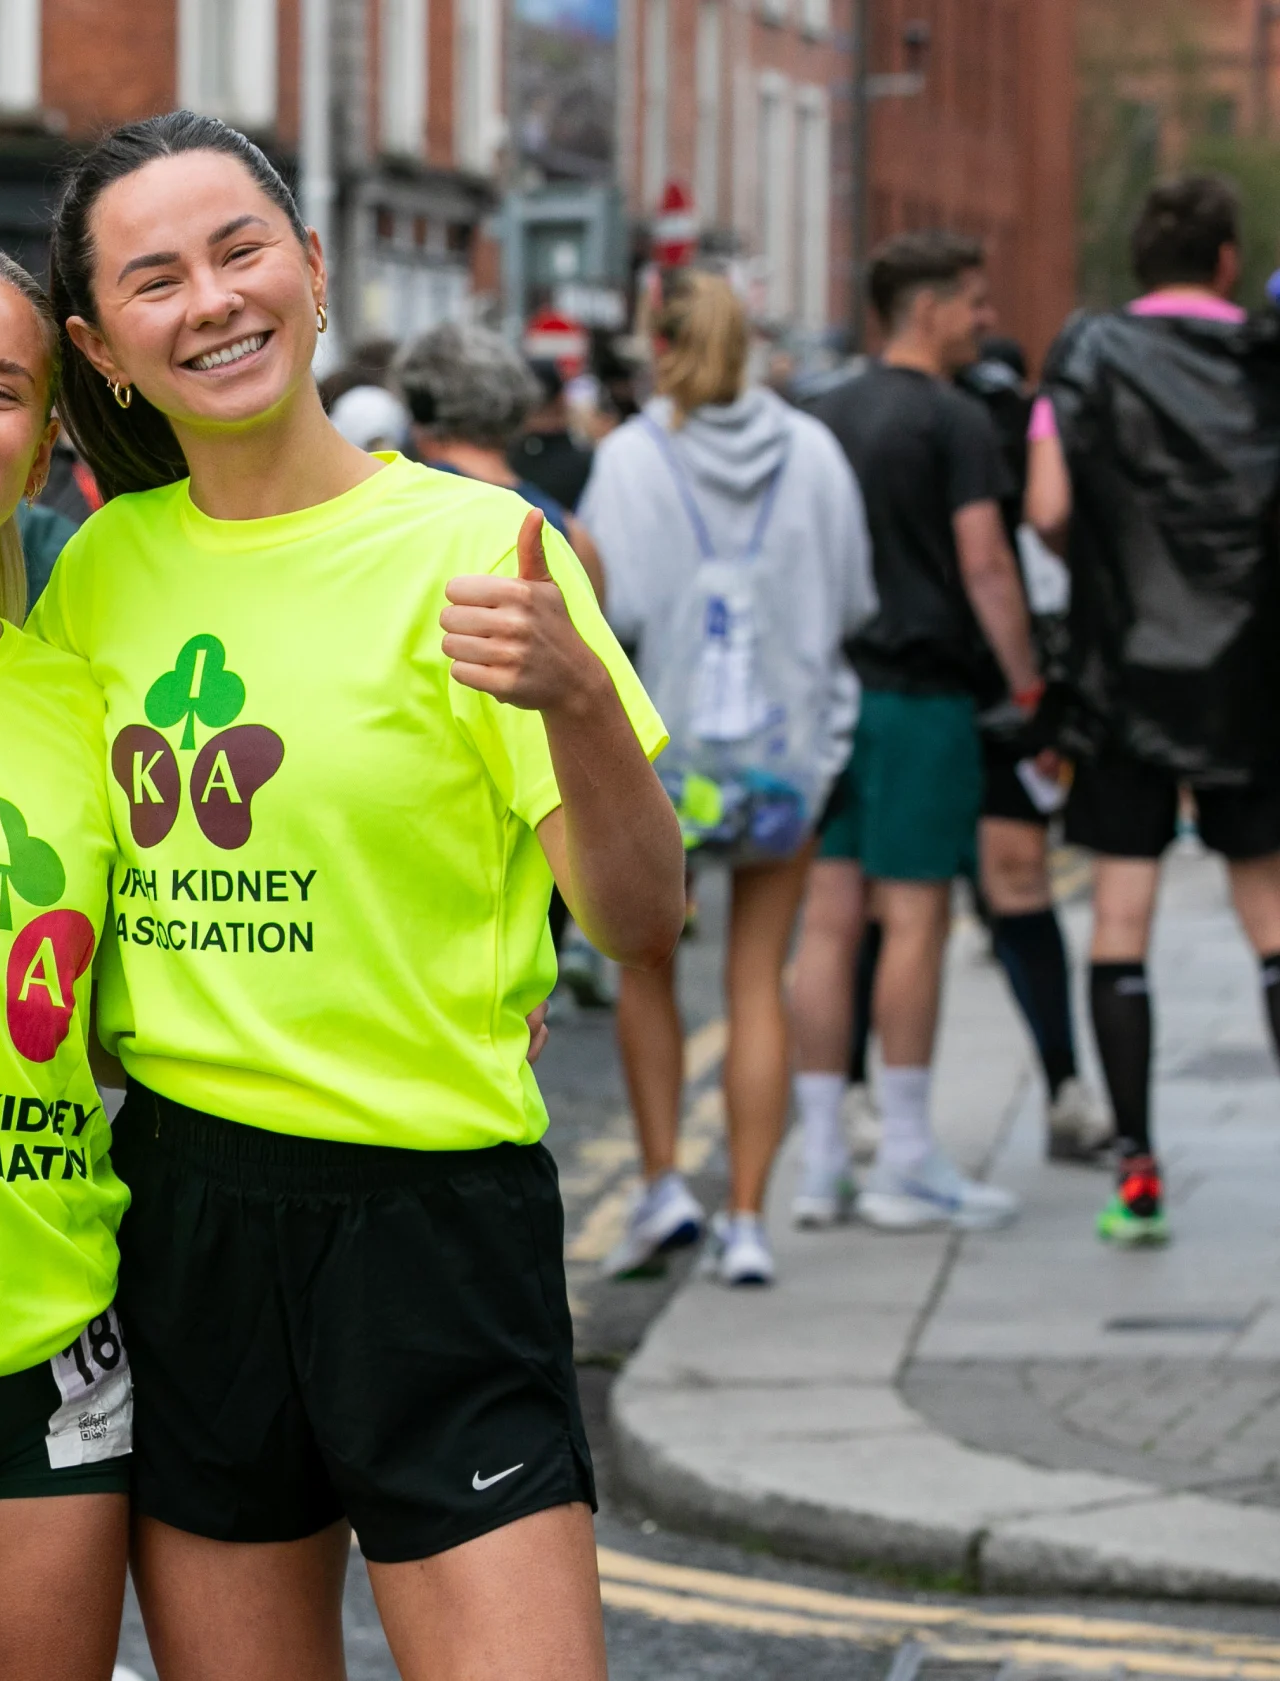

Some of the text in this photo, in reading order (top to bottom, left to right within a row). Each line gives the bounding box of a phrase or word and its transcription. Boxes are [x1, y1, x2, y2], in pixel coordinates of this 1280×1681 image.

[189, 649, 207, 698] I
[133, 749, 243, 804] K A
[172, 870, 318, 902] KIDNEY
[18, 937, 66, 1008] A
